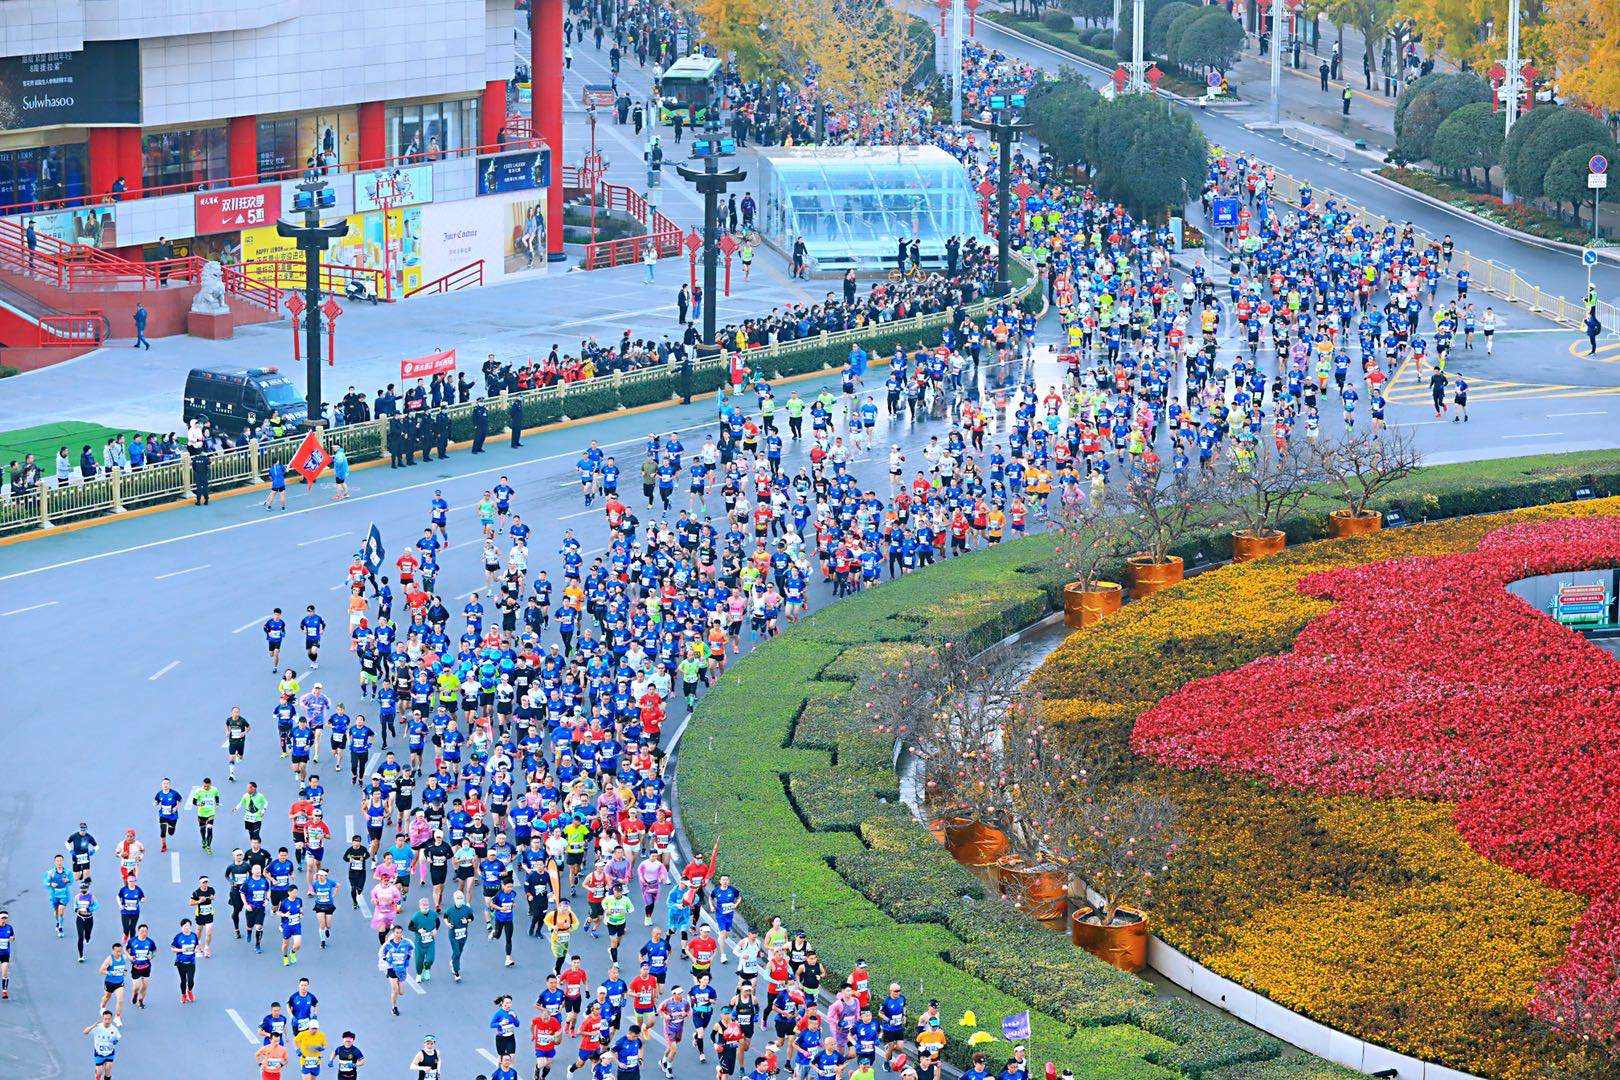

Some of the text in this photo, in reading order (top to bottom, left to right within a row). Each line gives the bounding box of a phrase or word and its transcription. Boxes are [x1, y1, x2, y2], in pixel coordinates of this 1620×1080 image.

[23, 94, 74, 110] Sulwhasoo
[222, 194, 265, 212] 双11狂欢季
